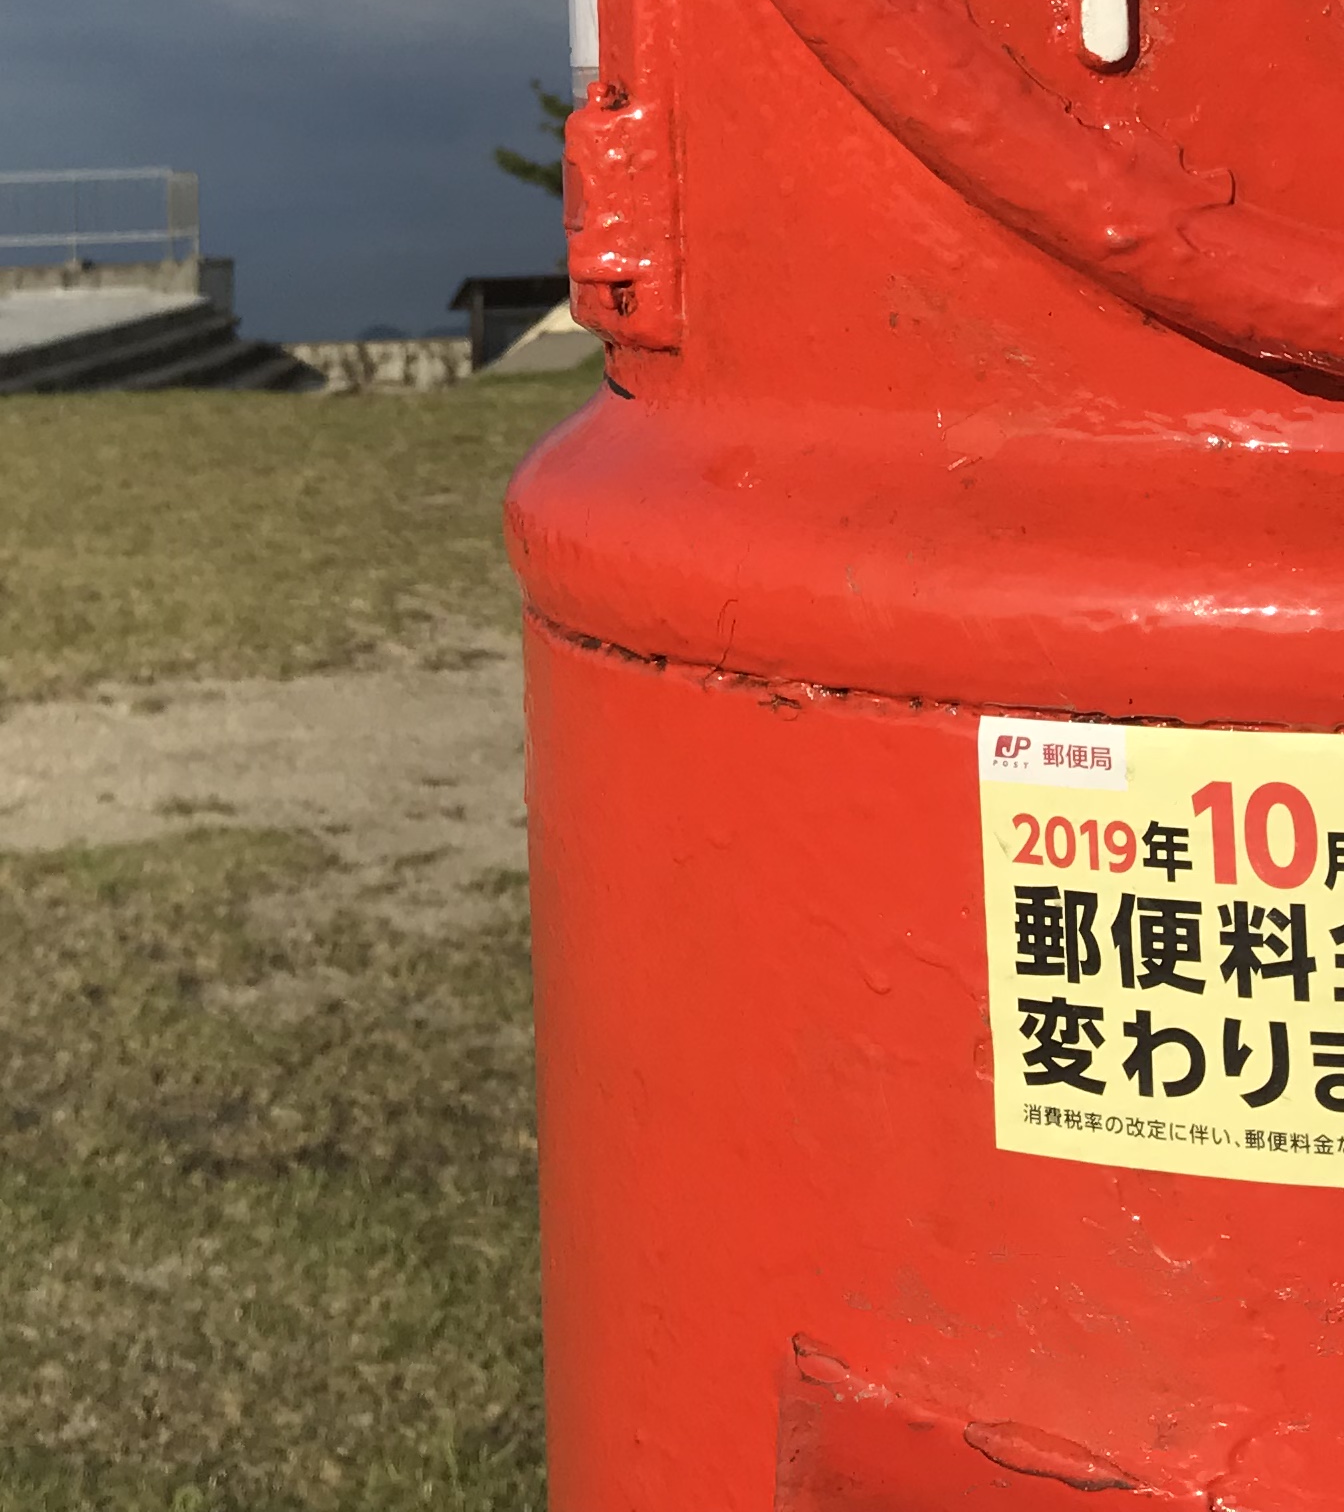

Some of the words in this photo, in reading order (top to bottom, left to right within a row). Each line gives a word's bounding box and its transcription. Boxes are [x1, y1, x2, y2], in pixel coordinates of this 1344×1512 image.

[993, 760, 1029, 769] POST
[1043, 743, 1112, 770] 郵便局
